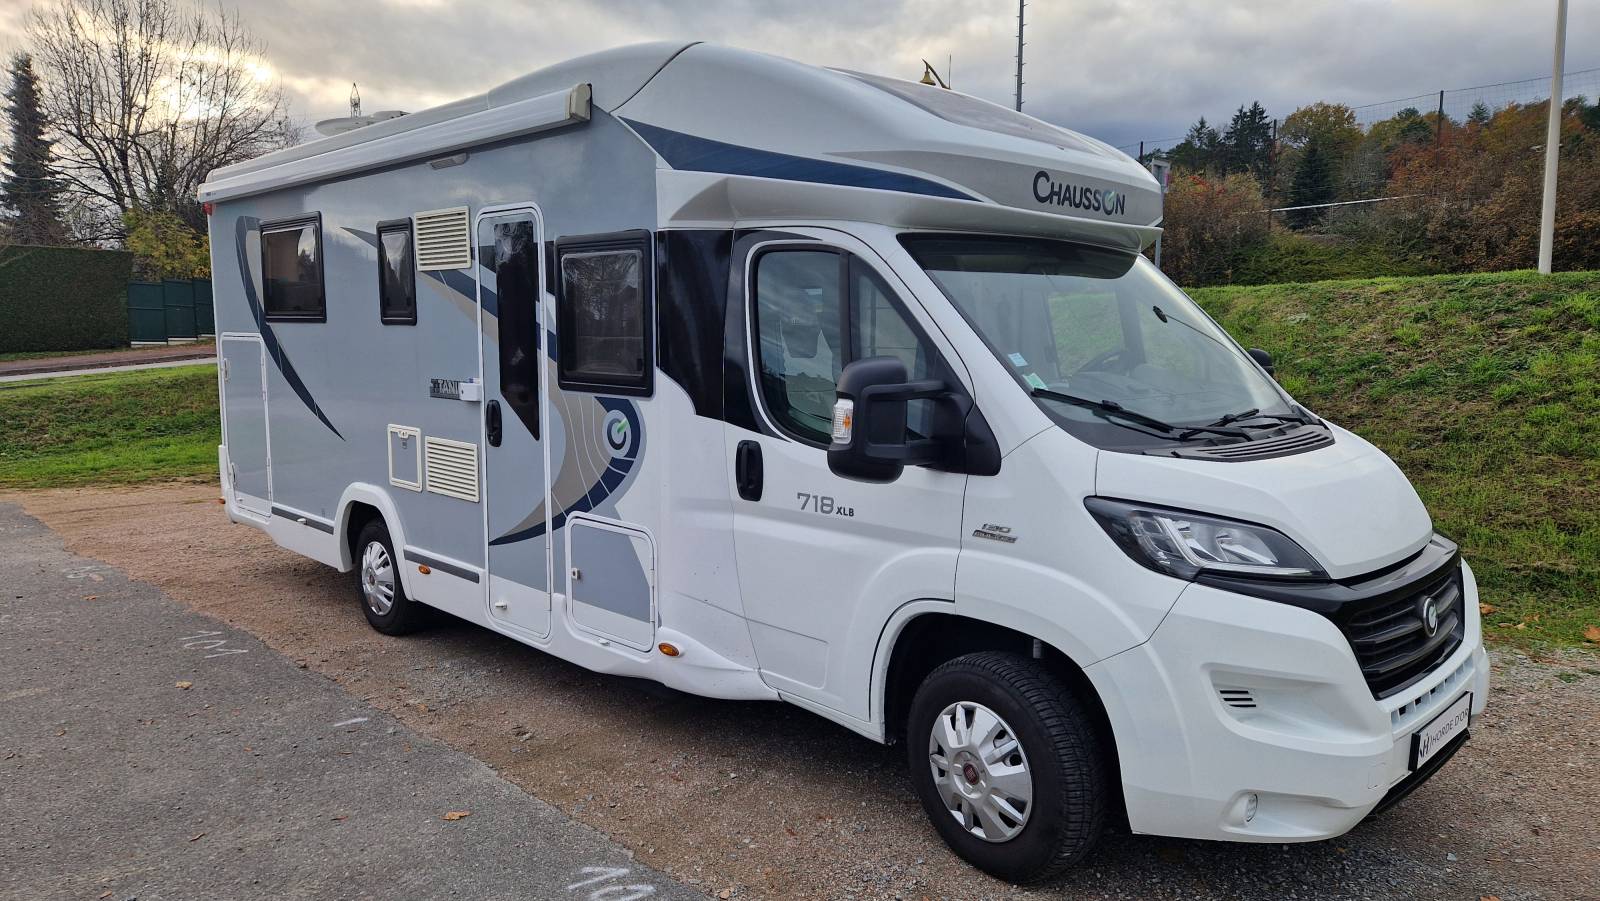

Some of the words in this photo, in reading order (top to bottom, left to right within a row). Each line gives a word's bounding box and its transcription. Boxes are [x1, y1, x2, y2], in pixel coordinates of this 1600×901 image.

[1033, 171, 1126, 216] CHAUSSON
[797, 492, 835, 515] 718
[836, 506, 855, 517] XLB
